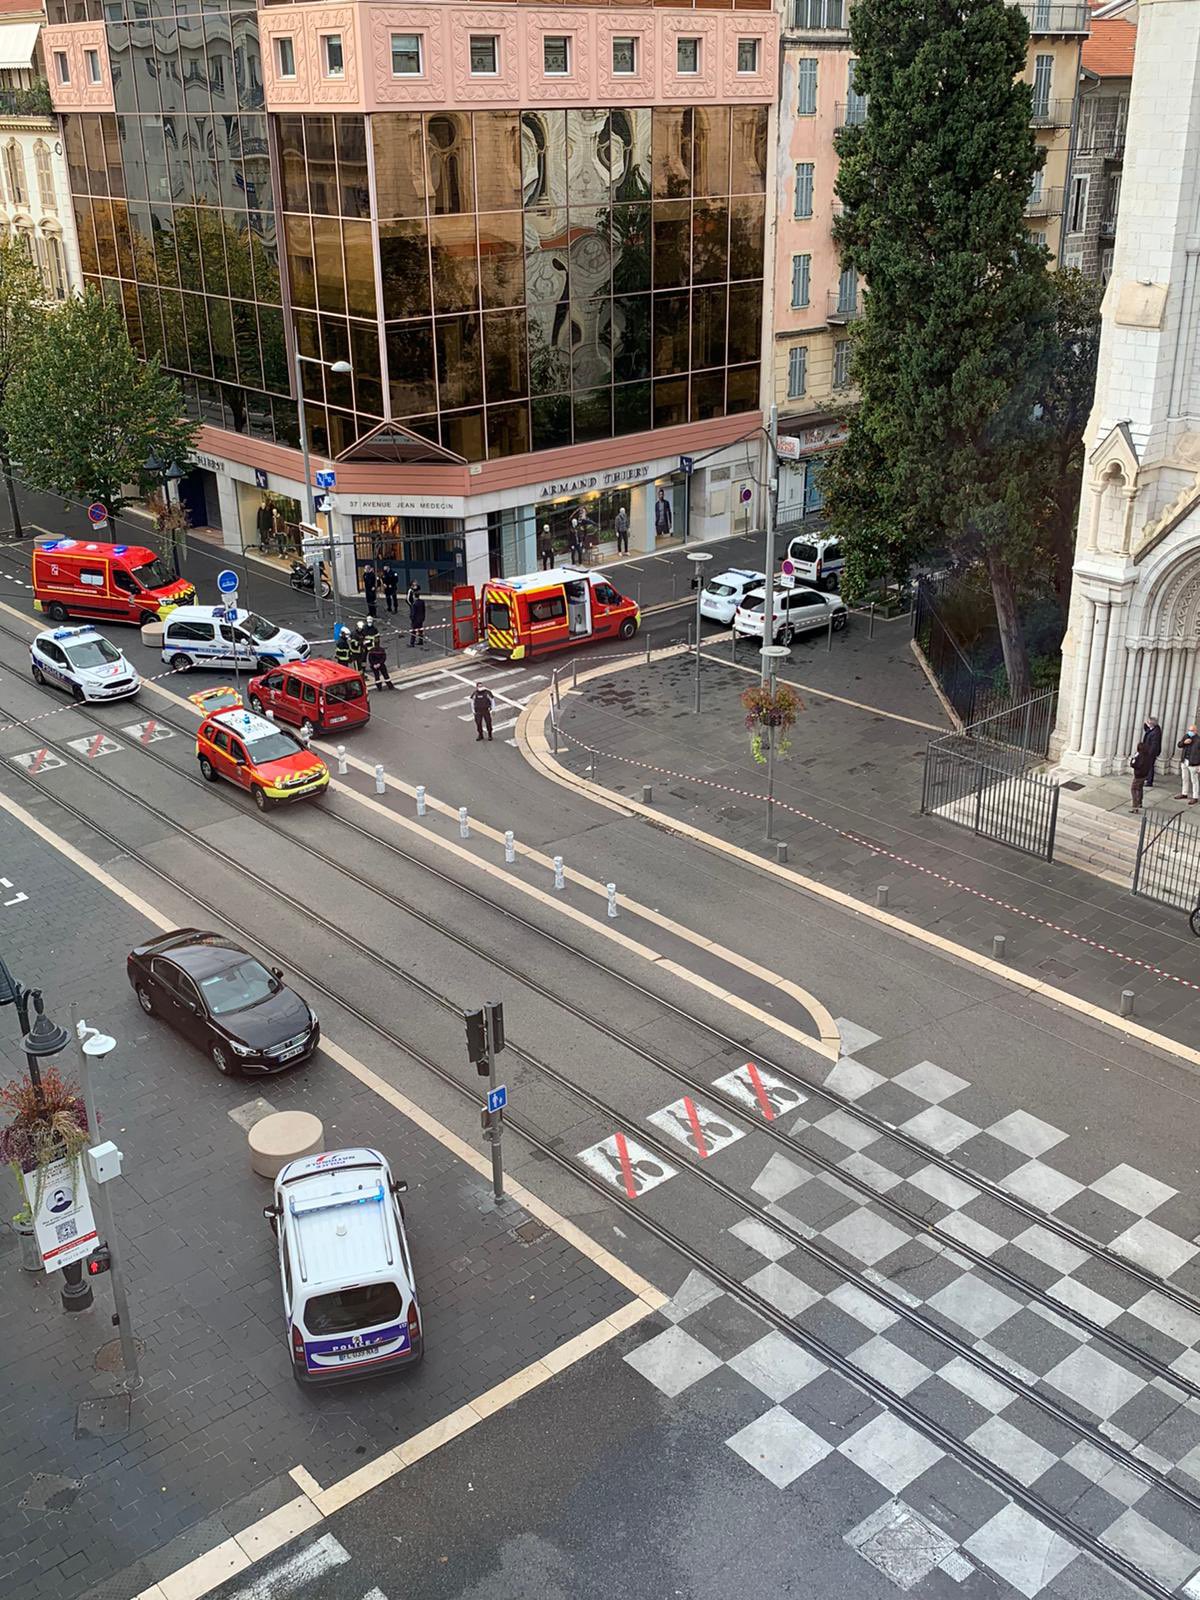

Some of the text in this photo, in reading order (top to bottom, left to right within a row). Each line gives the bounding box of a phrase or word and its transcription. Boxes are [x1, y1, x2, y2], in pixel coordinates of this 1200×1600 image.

[540, 465, 649, 497] ARMAND THIERY
[349, 500, 358, 508] 37
[332, 1340, 370, 1351] POLICE
